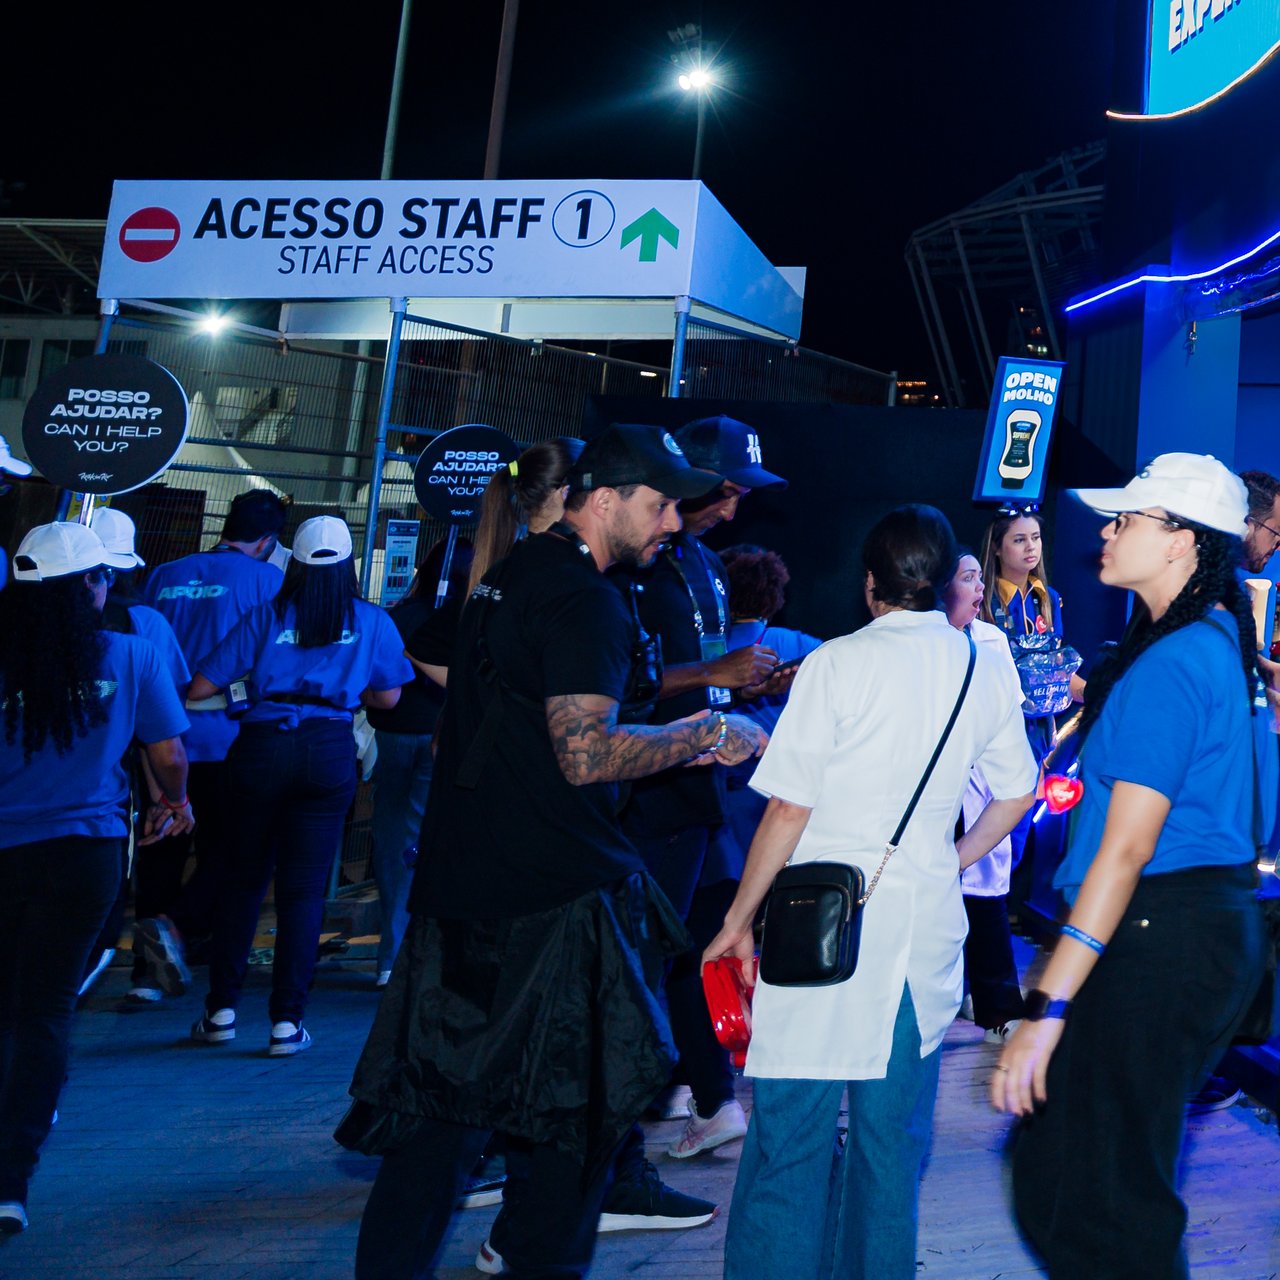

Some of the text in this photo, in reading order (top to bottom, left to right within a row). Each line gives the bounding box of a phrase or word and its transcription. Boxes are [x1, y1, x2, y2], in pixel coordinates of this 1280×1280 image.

[193, 197, 593, 240] ACESSO STAFF 1
[277, 245, 496, 275] STAFF ACCESS
[1006, 371, 1057, 393] OPEN
[67, 388, 151, 404] POSSO
[1003, 388, 1054, 406] MOLHO
[50, 404, 163, 420] AJUDAR?
[44, 423, 162, 438] CAN I HELP
[73, 440, 129, 453] YOU?
[444, 450, 500, 461] POSSO
[428, 475, 490, 484] CAN I HE
[447, 486, 485, 496] YOU?
[157, 584, 229, 601] APOIO
